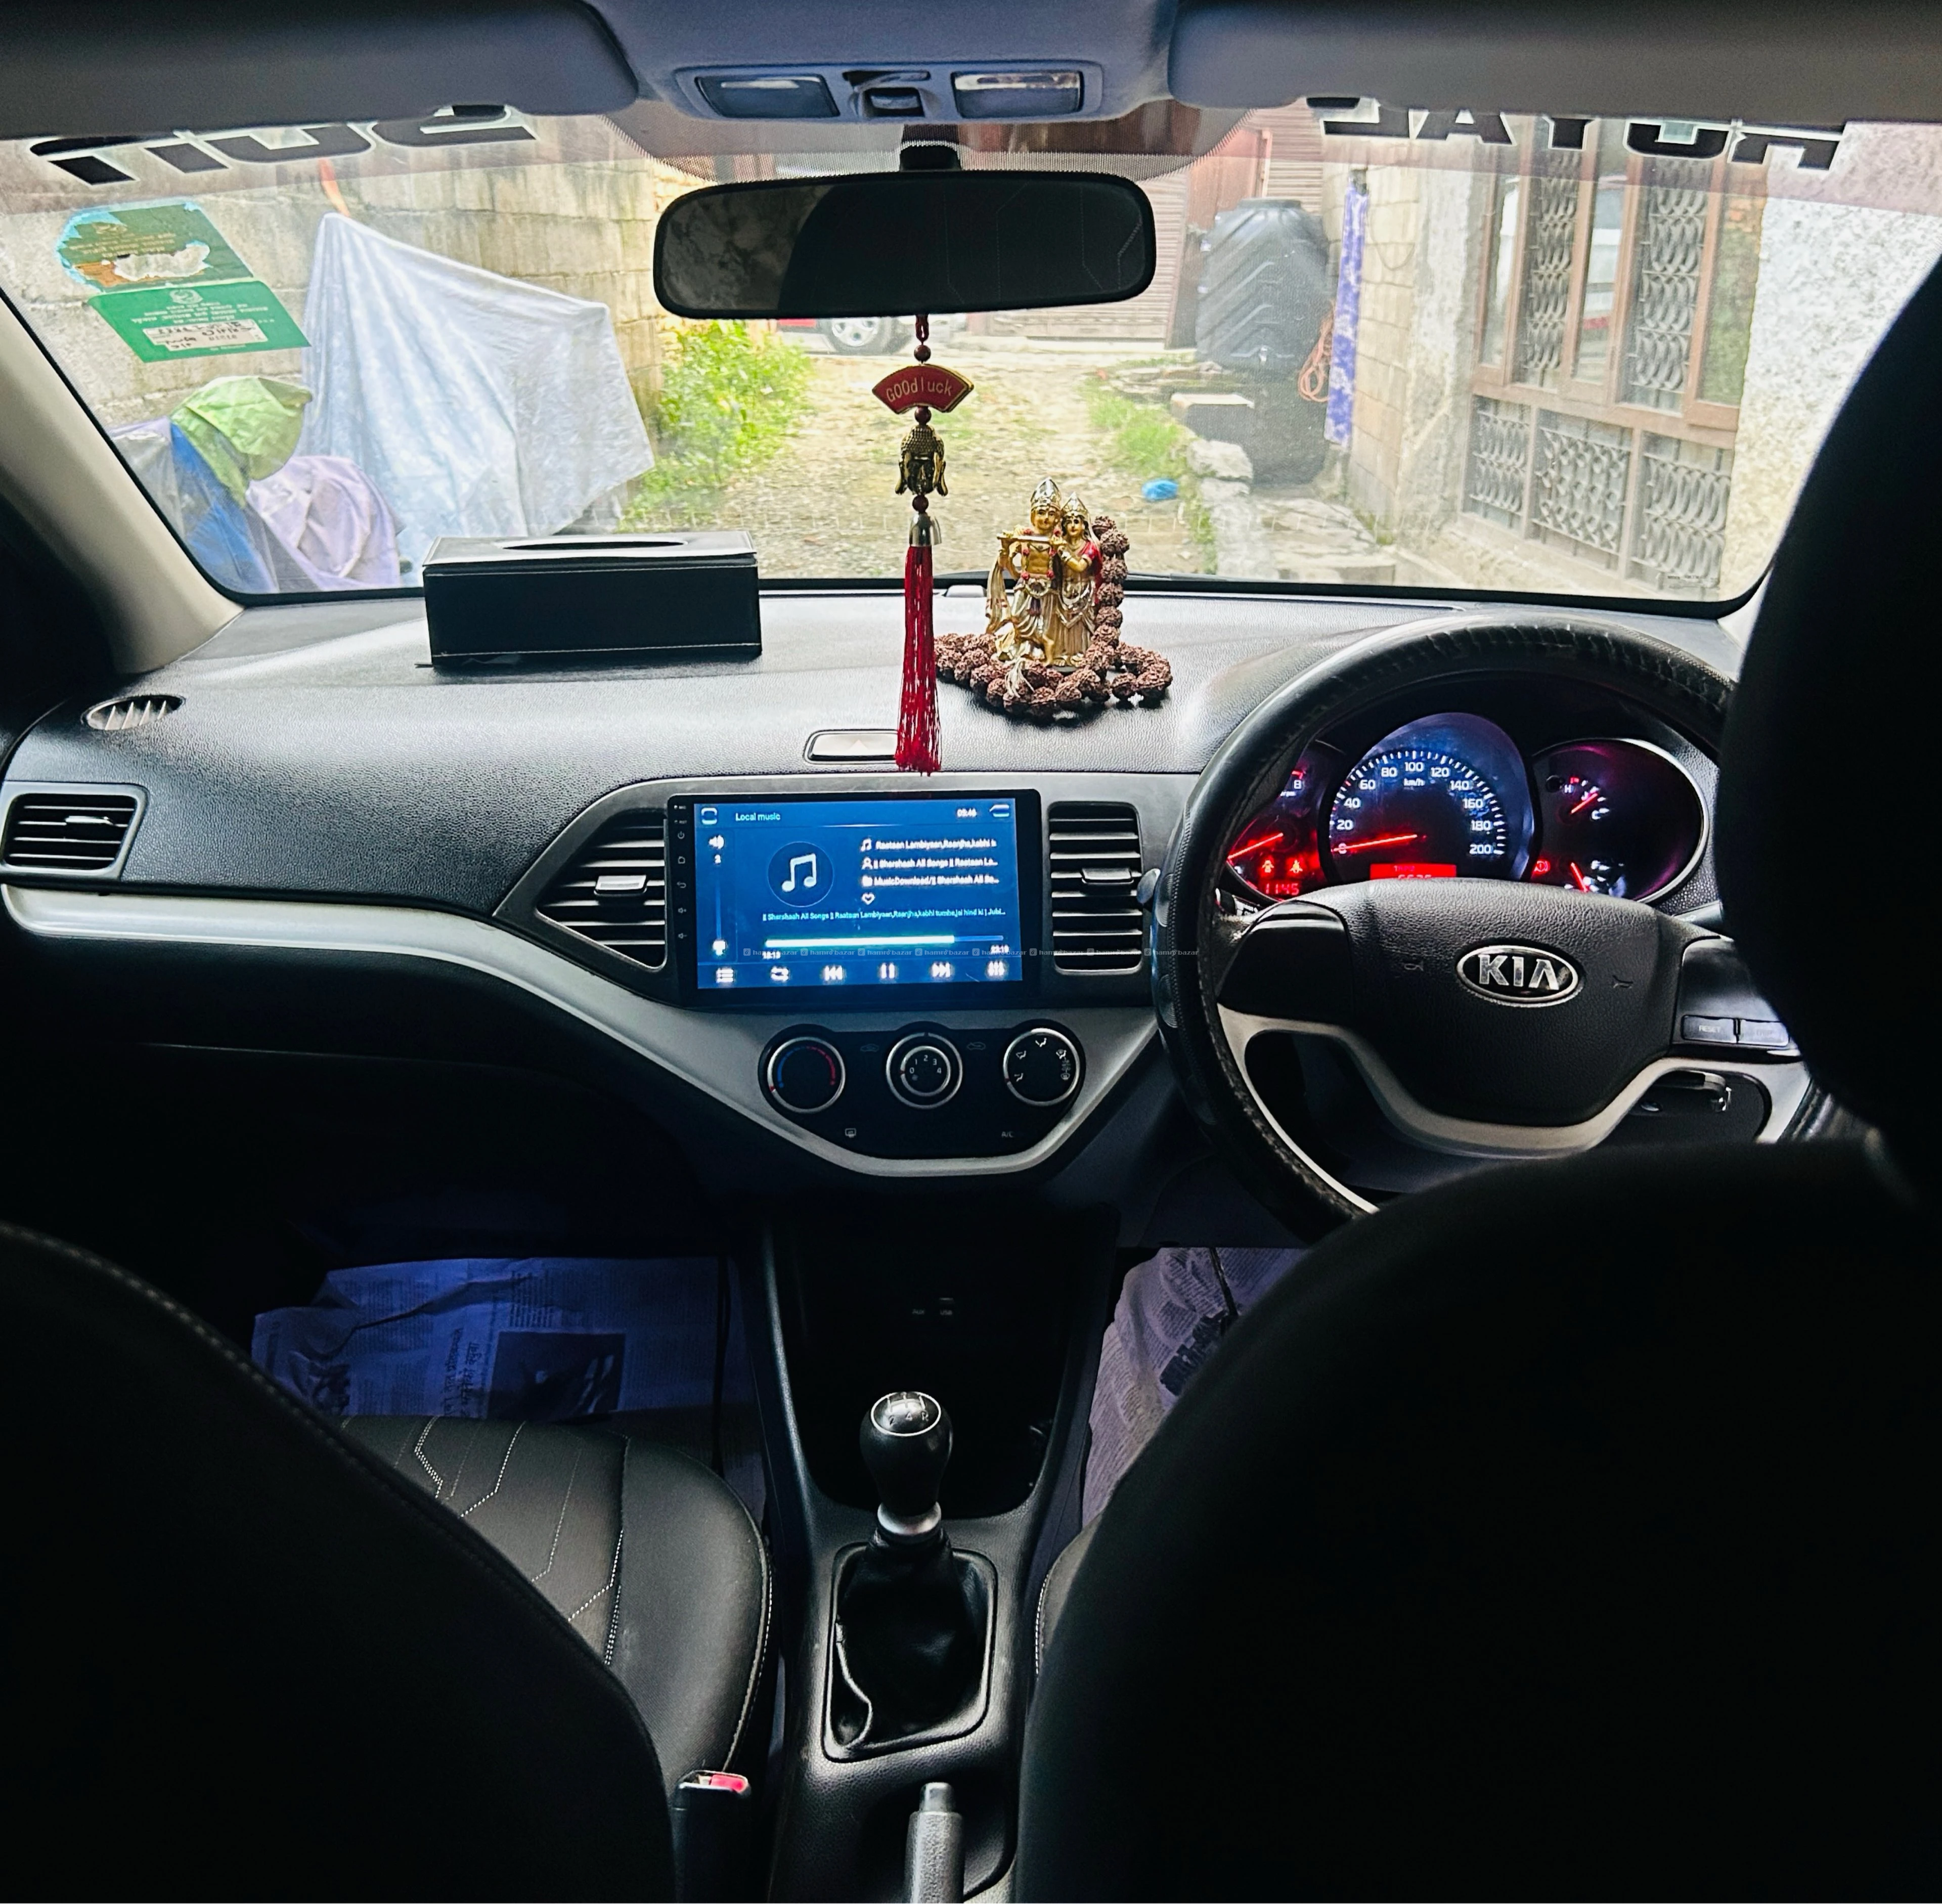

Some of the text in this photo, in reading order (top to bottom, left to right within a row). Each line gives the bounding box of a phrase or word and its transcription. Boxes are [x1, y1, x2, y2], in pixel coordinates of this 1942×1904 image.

[1381, 767, 1397, 777] 80
[1404, 762, 1424, 772] 100
[1431, 767, 1450, 777] 120
[1293, 779, 1302, 789] 8
[1360, 780, 1376, 789] 60
[1404, 778, 1425, 786] km/h
[1450, 780, 1469, 790] 140
[1564, 784, 1572, 793] H
[1344, 798, 1361, 808] 40
[1463, 799, 1483, 808] 160
[735, 812, 780, 821] Local music
[1337, 820, 1353, 830] 20
[1471, 820, 1491, 830] 180
[1470, 845, 1492, 855] 200
[810, 912, 829, 920] Songs
[1478, 954, 1559, 990] KIA
[1699, 1025, 1721, 1033] RESET
[921, 1410, 929, 1422] R
